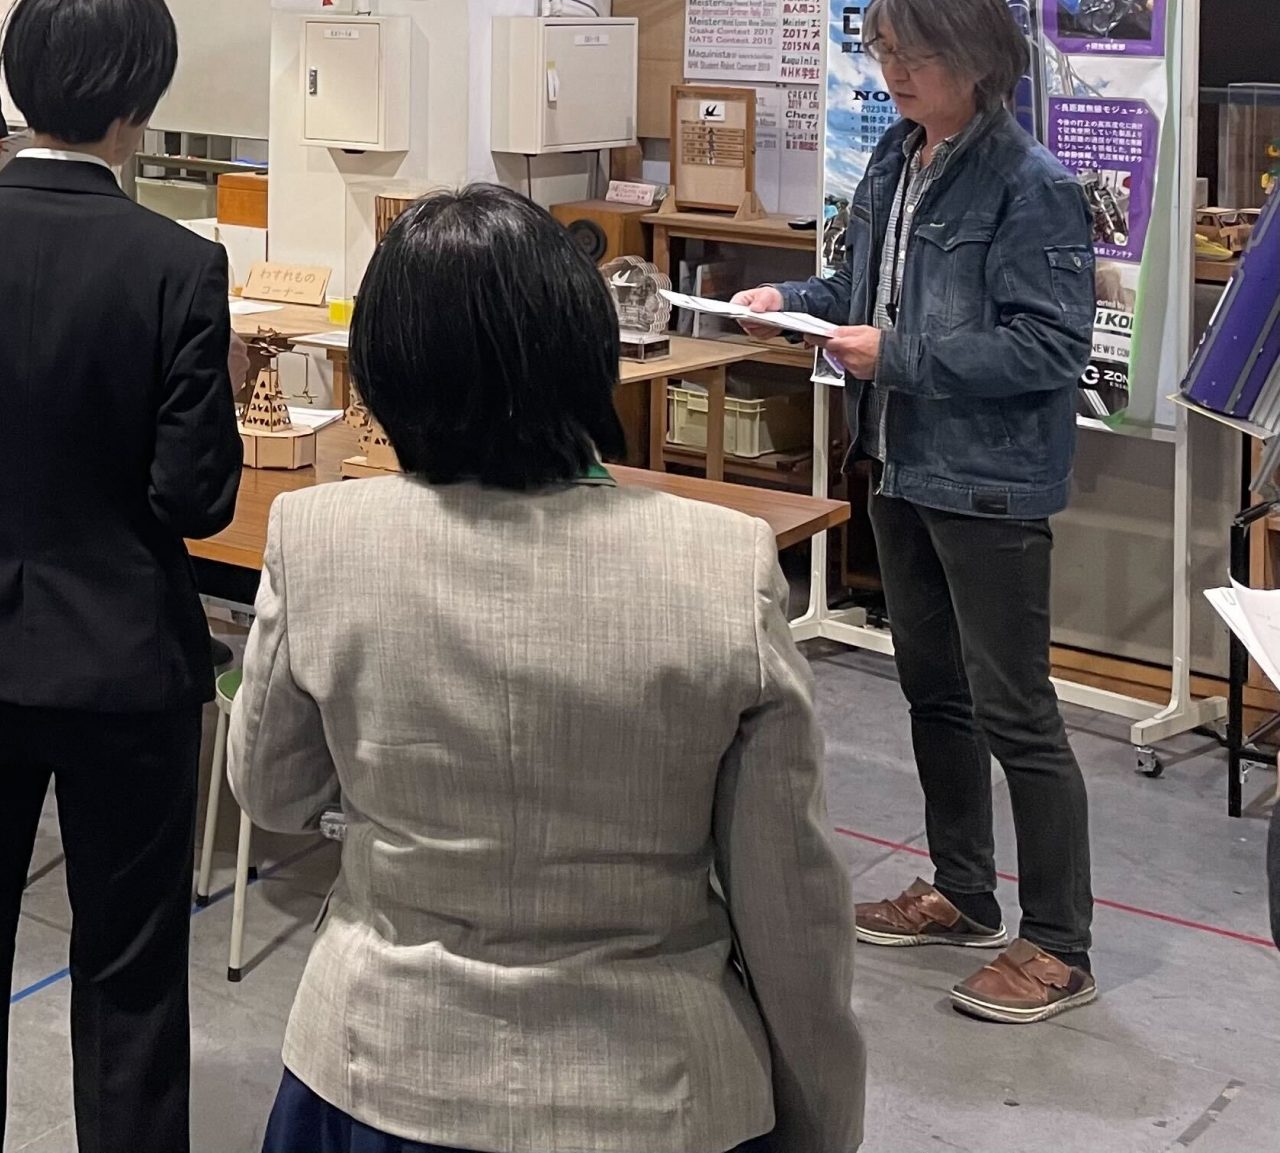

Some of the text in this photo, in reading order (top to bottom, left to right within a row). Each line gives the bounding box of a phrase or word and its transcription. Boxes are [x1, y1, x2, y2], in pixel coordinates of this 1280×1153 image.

[260, 268, 316, 284] わすれもの
